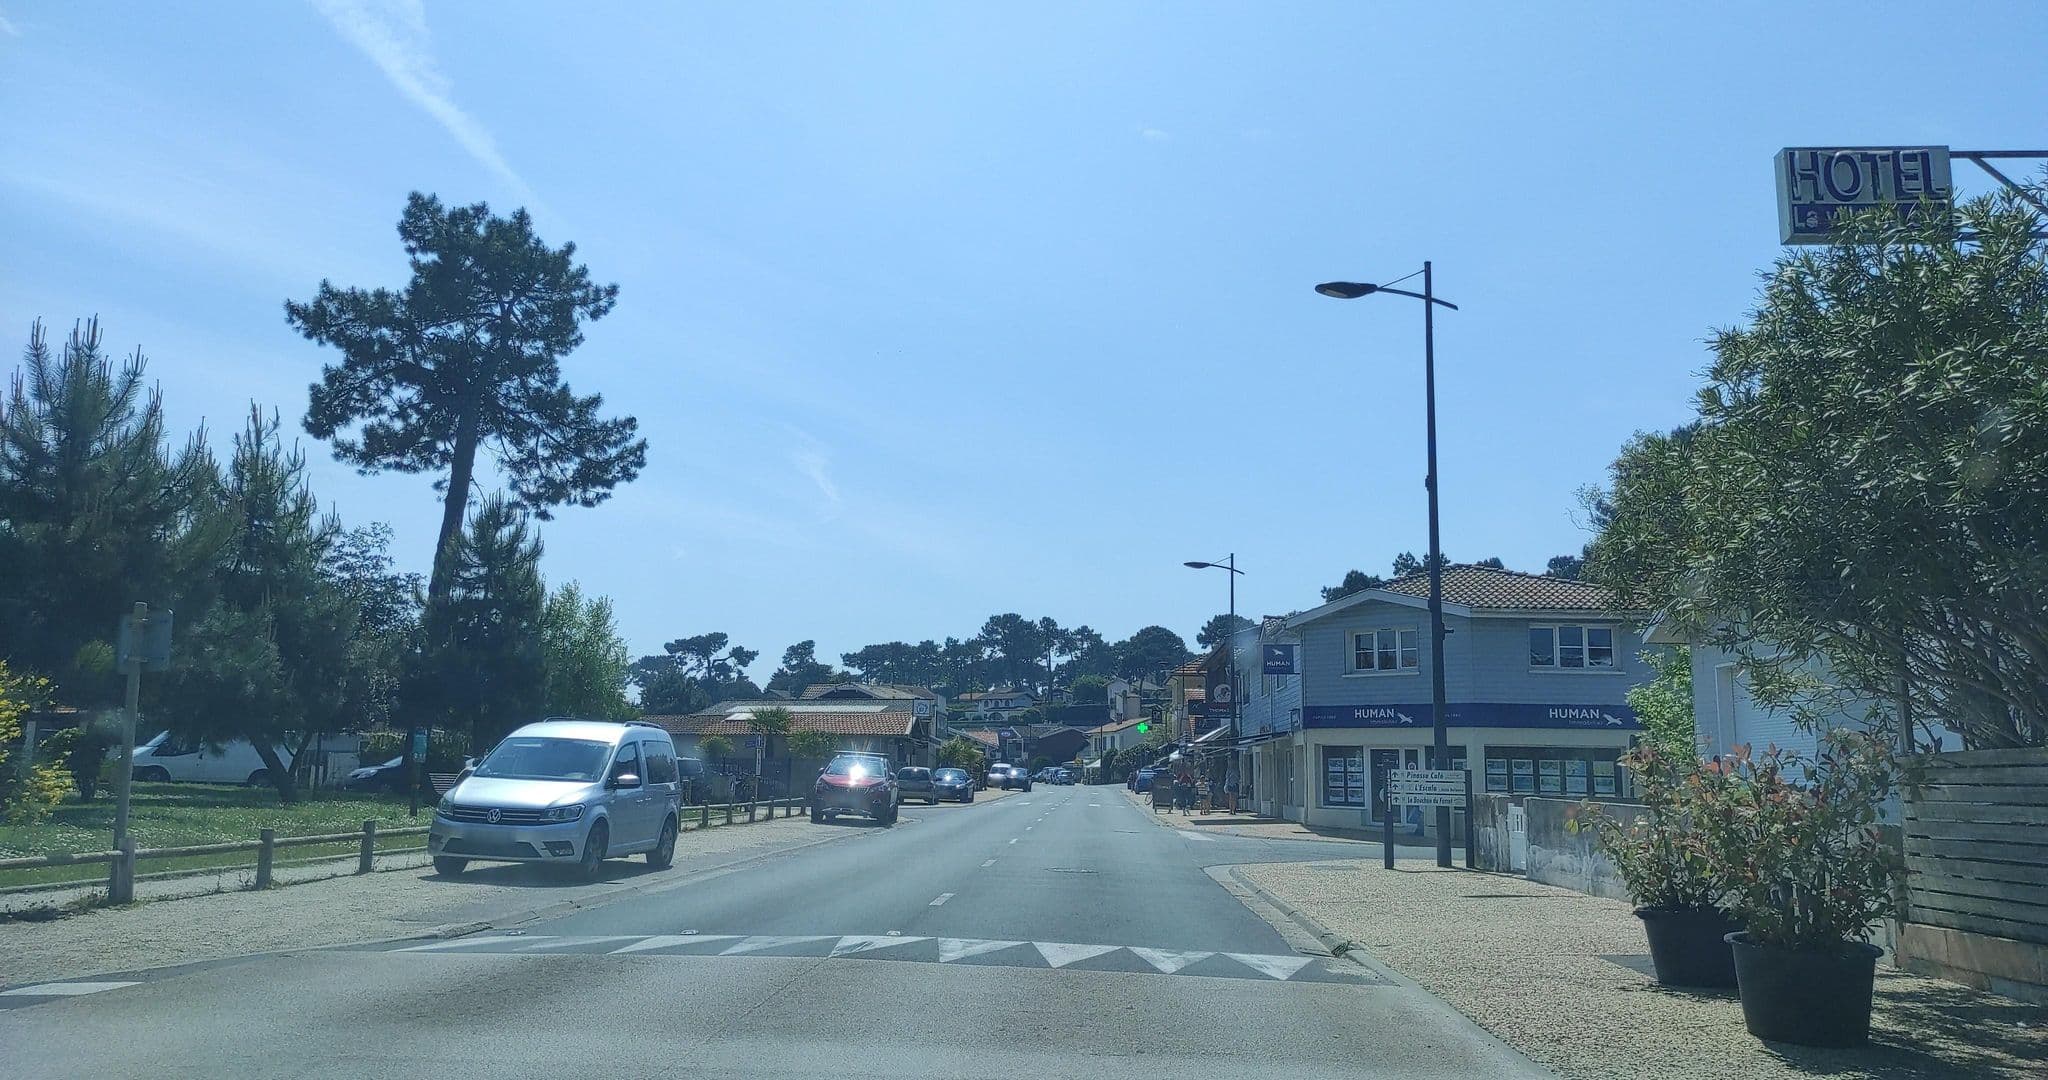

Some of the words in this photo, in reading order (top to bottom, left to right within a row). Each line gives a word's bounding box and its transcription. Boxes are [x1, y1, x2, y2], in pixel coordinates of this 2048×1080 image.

[1788, 149, 1946, 202] HOTEL
[1354, 708, 1394, 719] HUMAN
[1549, 708, 1600, 719] HUMAN
